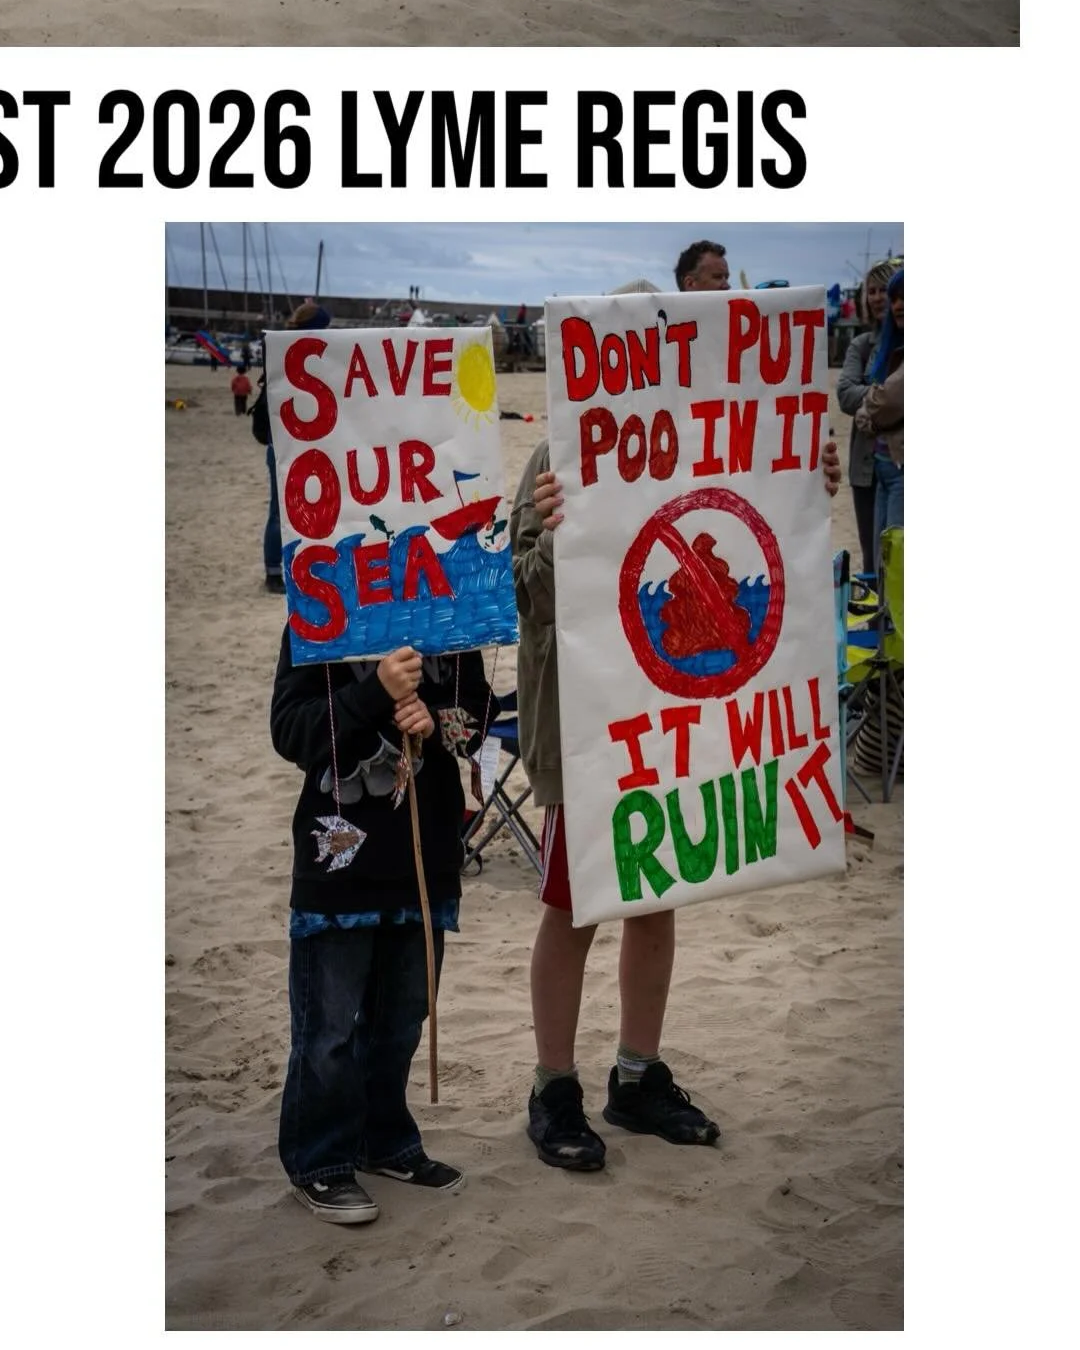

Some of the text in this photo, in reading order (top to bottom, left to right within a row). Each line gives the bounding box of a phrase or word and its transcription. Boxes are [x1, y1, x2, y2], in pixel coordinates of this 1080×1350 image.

[280, 337, 454, 441] SAVE
[561, 298, 824, 401] DON'T PUT
[285, 440, 444, 540] OUR
[580, 392, 829, 487] POO IN IT
[289, 534, 456, 644] SEA
[608, 705, 701, 791] IT
[725, 677, 831, 769] WILL
[612, 758, 779, 902] RUIN
[784, 741, 844, 850] IT
